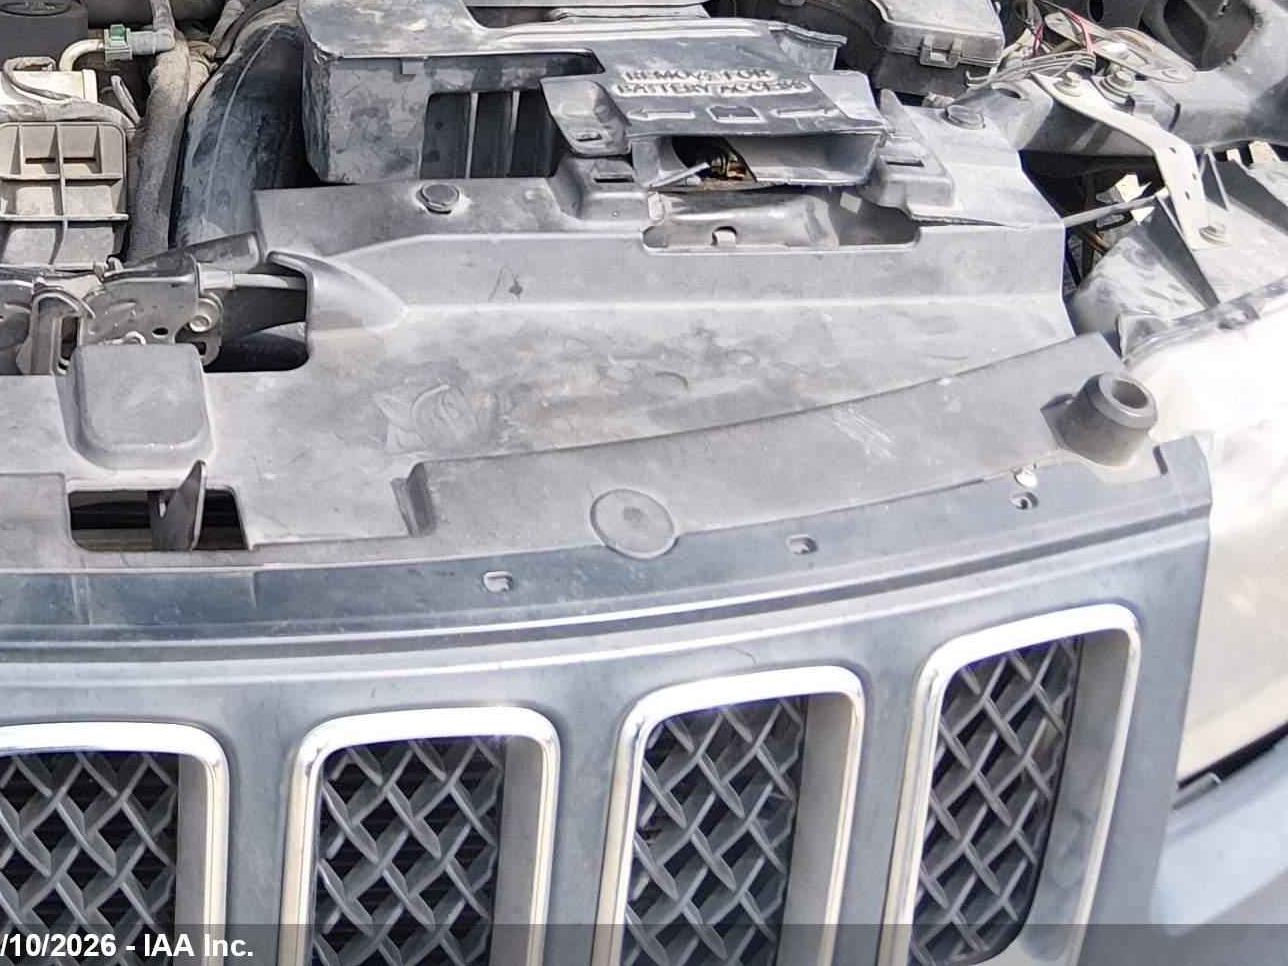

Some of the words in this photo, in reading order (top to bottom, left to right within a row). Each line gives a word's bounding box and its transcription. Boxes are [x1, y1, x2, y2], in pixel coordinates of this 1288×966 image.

[624, 70, 713, 82] REMOVE
[720, 68, 773, 80] FOR
[616, 83, 710, 95] BATTERY
[720, 80, 807, 94] ACCESS
